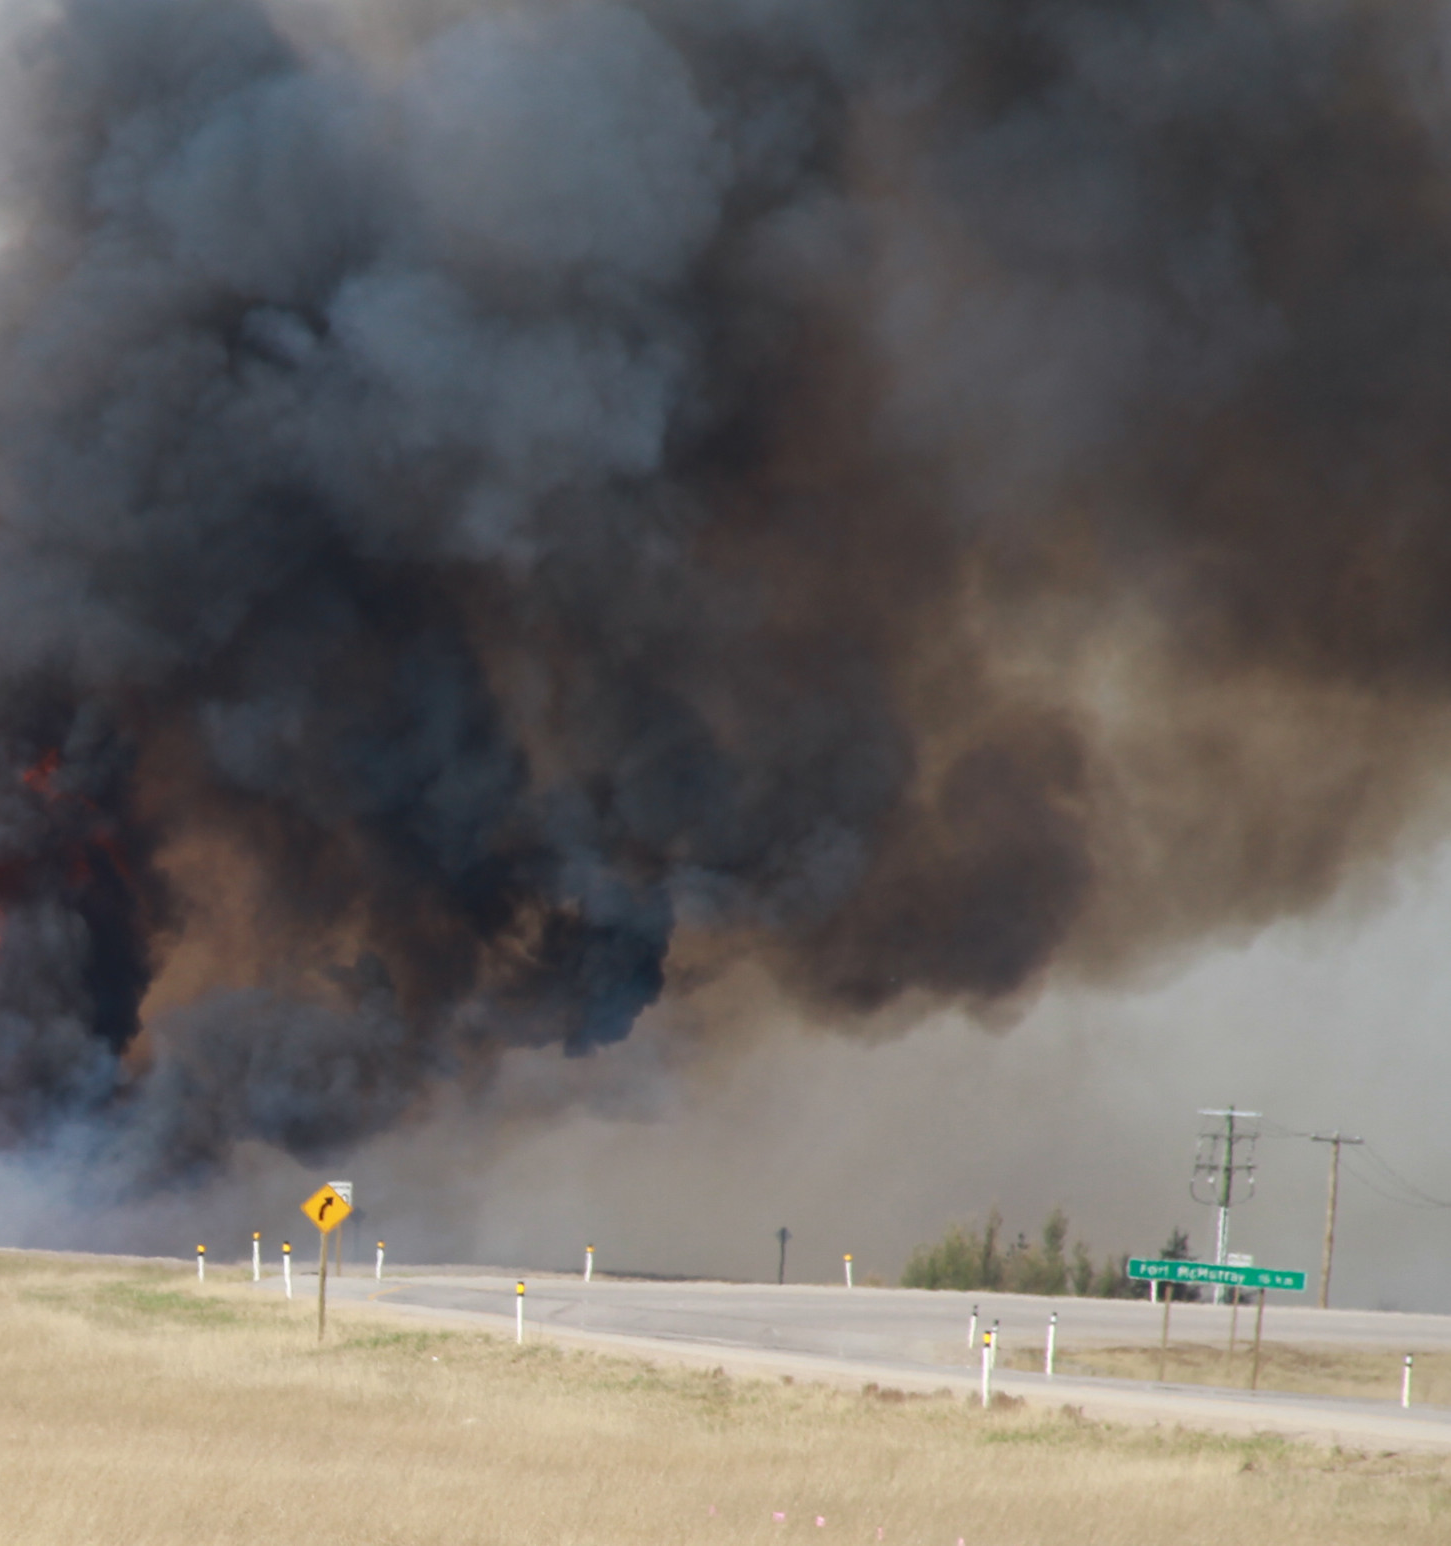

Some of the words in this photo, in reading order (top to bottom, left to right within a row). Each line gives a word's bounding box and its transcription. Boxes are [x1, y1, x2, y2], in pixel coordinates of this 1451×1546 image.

[1140, 1263, 1169, 1276] Fort
[1177, 1265, 1246, 1284] McMurray
[1275, 1274, 1294, 1286] km
